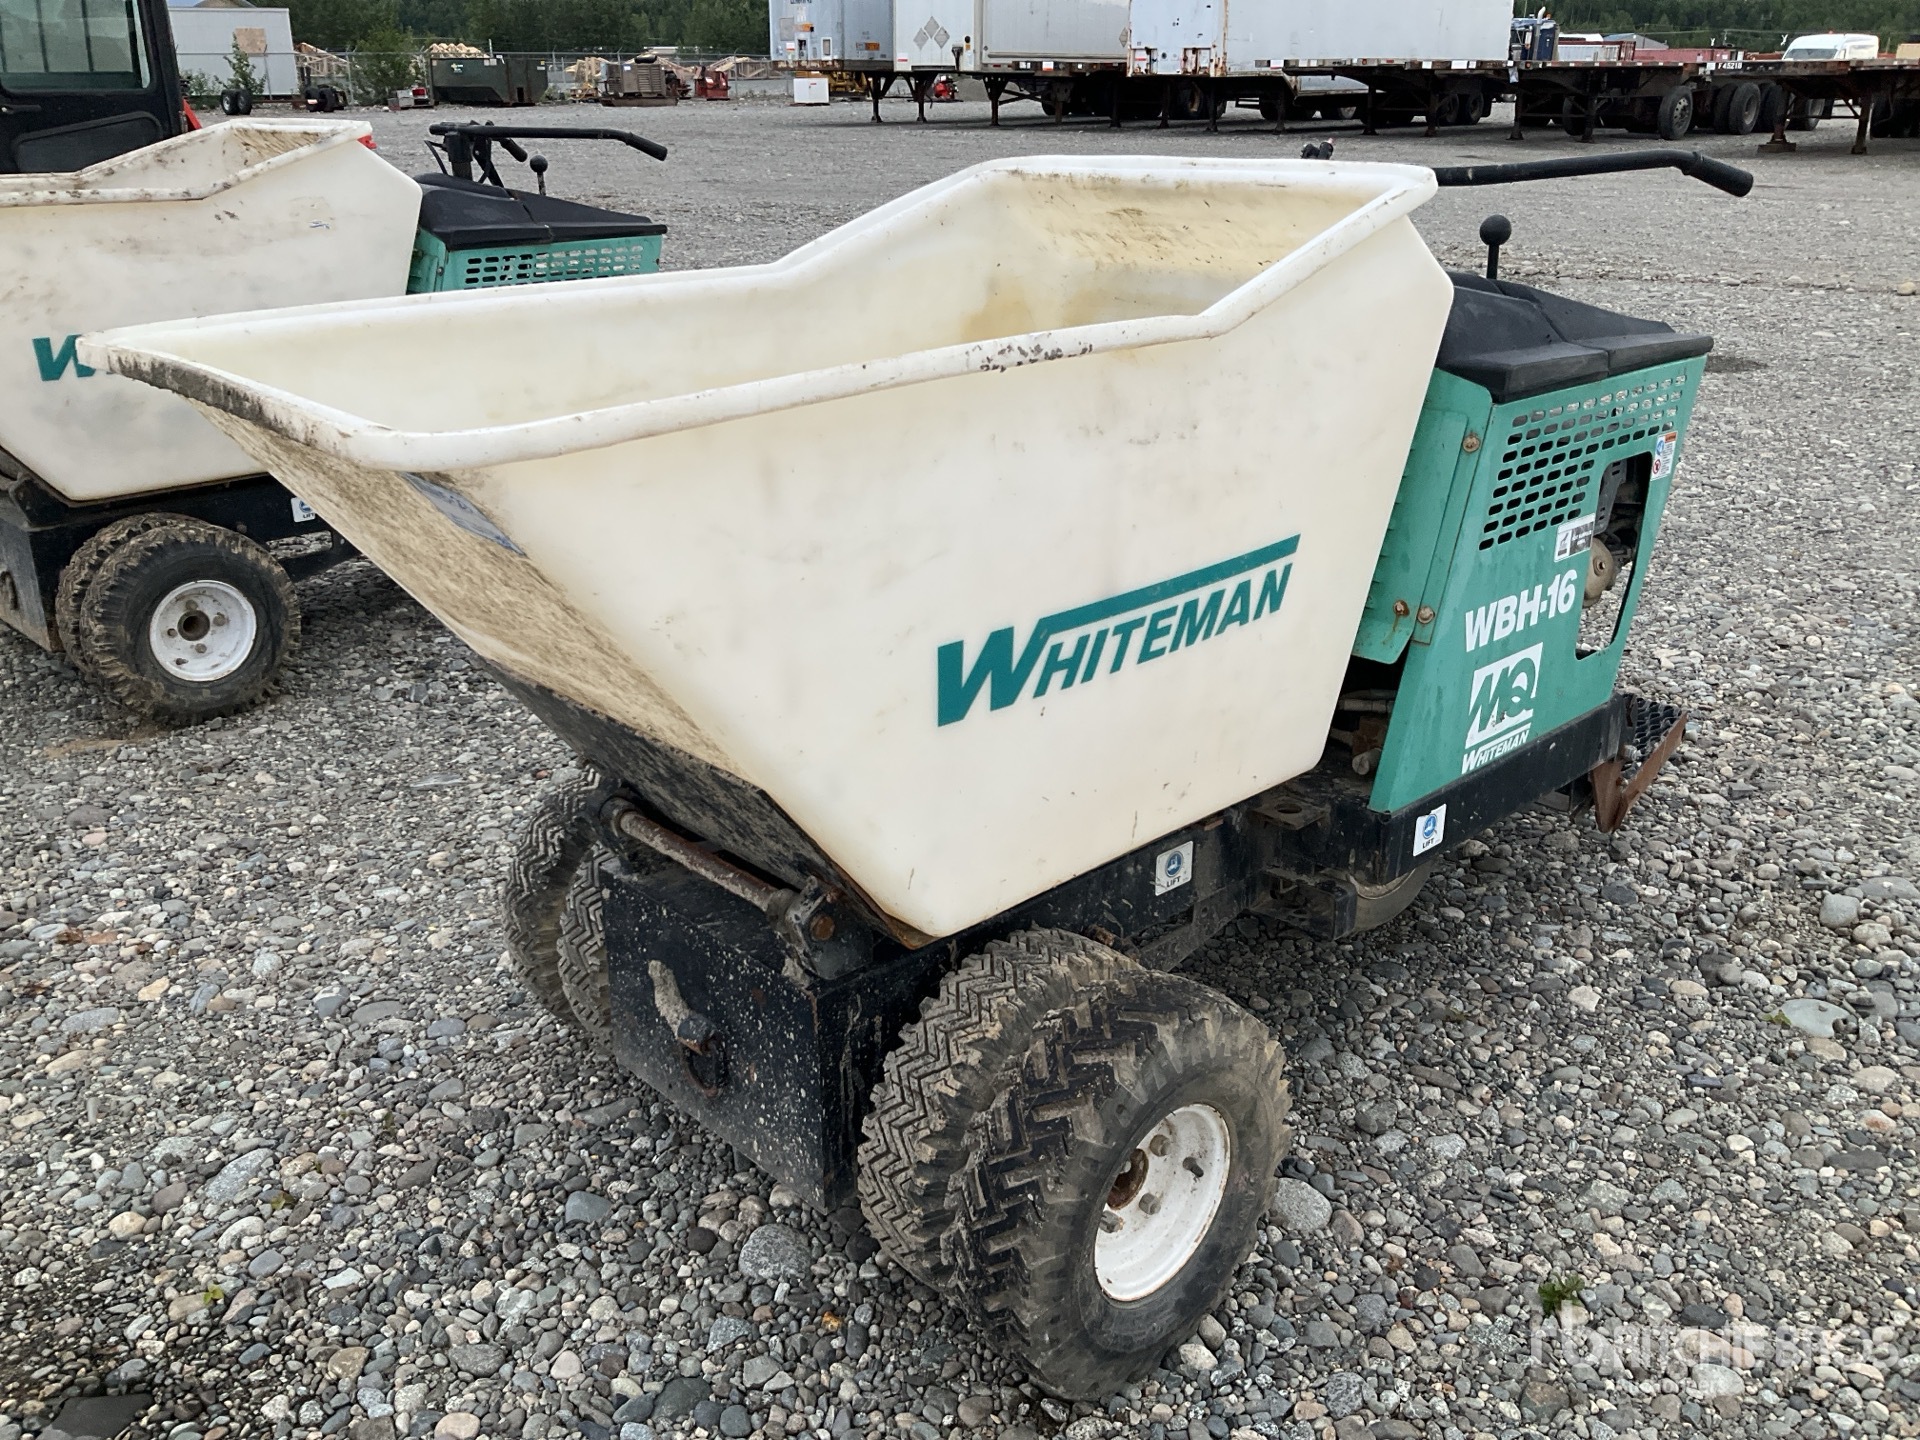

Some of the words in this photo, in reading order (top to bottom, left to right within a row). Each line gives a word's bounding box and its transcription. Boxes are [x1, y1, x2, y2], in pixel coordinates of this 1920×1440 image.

[937, 533, 1301, 727] WHITEMAN
[1465, 569, 1578, 653] WBH-16
[1461, 722, 1532, 775] WHITEMAN
